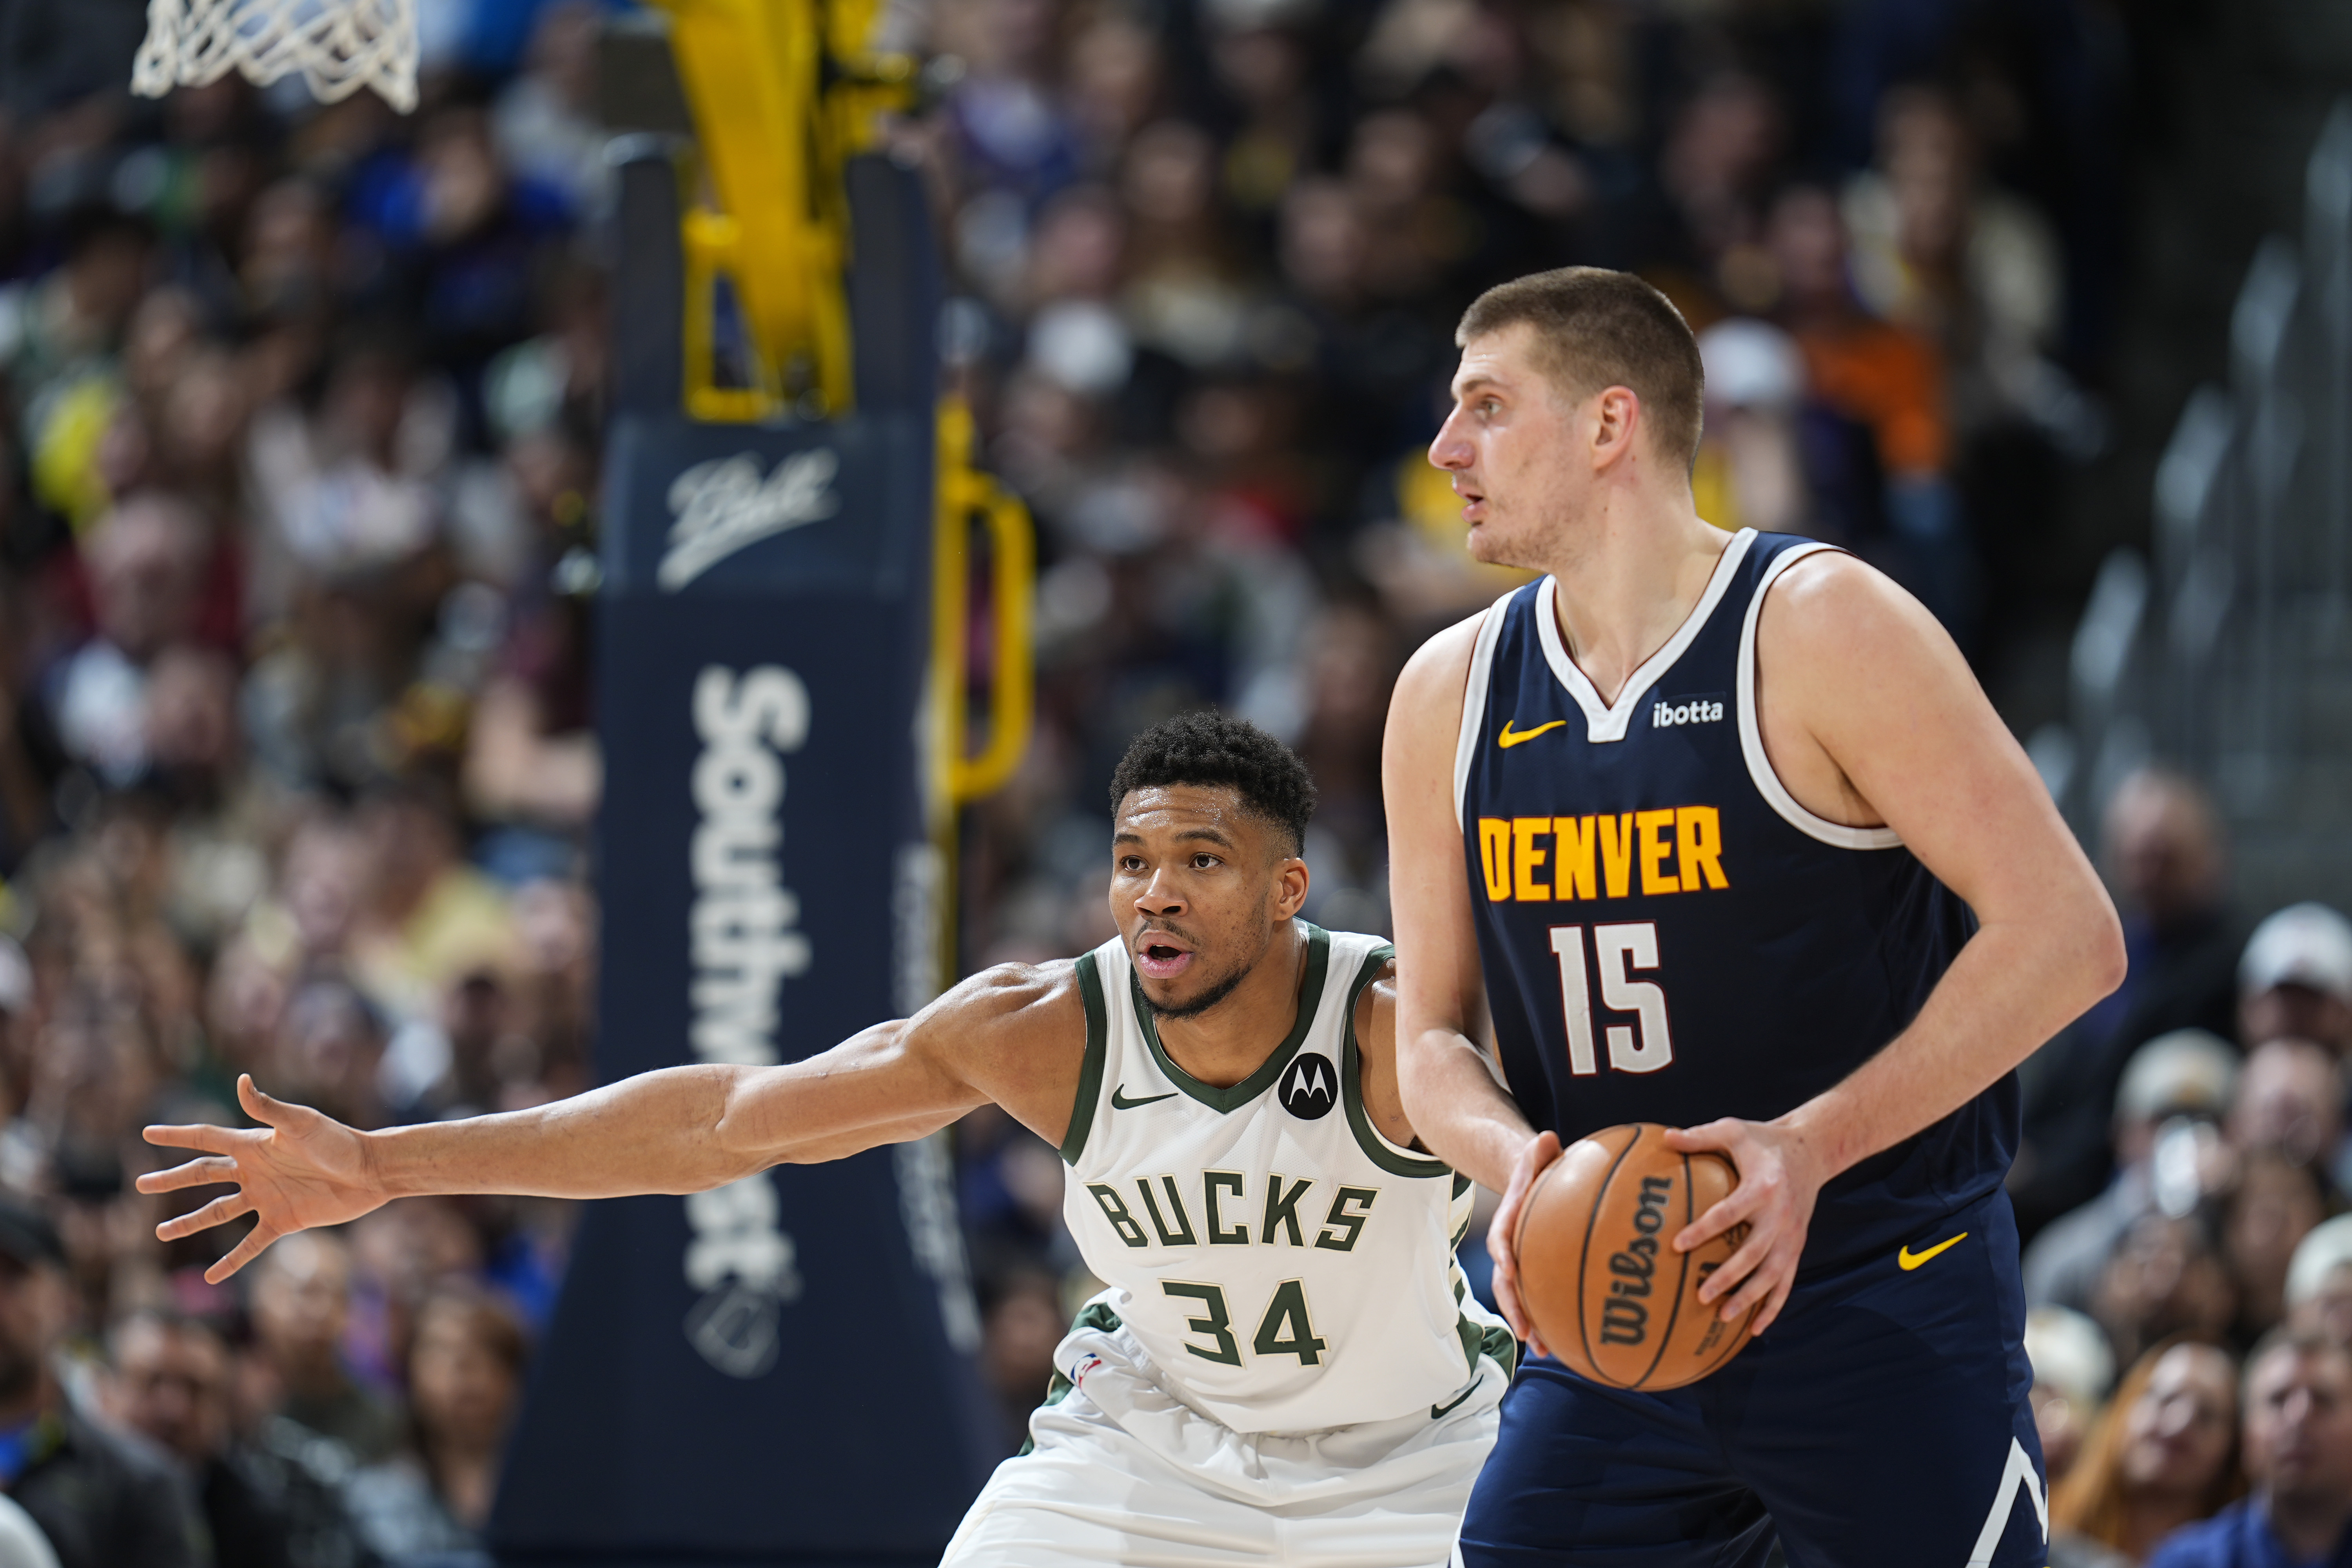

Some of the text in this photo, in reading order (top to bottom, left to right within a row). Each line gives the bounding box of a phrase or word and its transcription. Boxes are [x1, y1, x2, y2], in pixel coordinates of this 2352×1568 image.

[1653, 700, 1724, 728] ibotta
[1478, 805, 1731, 903] DENVER
[683, 664, 812, 1294] Southwst
[1548, 920, 1675, 1076] 15
[1083, 1168, 1381, 1252] BUCKS
[1599, 1176, 1673, 1346] Wilson
[1158, 1277, 1330, 1369] 34
